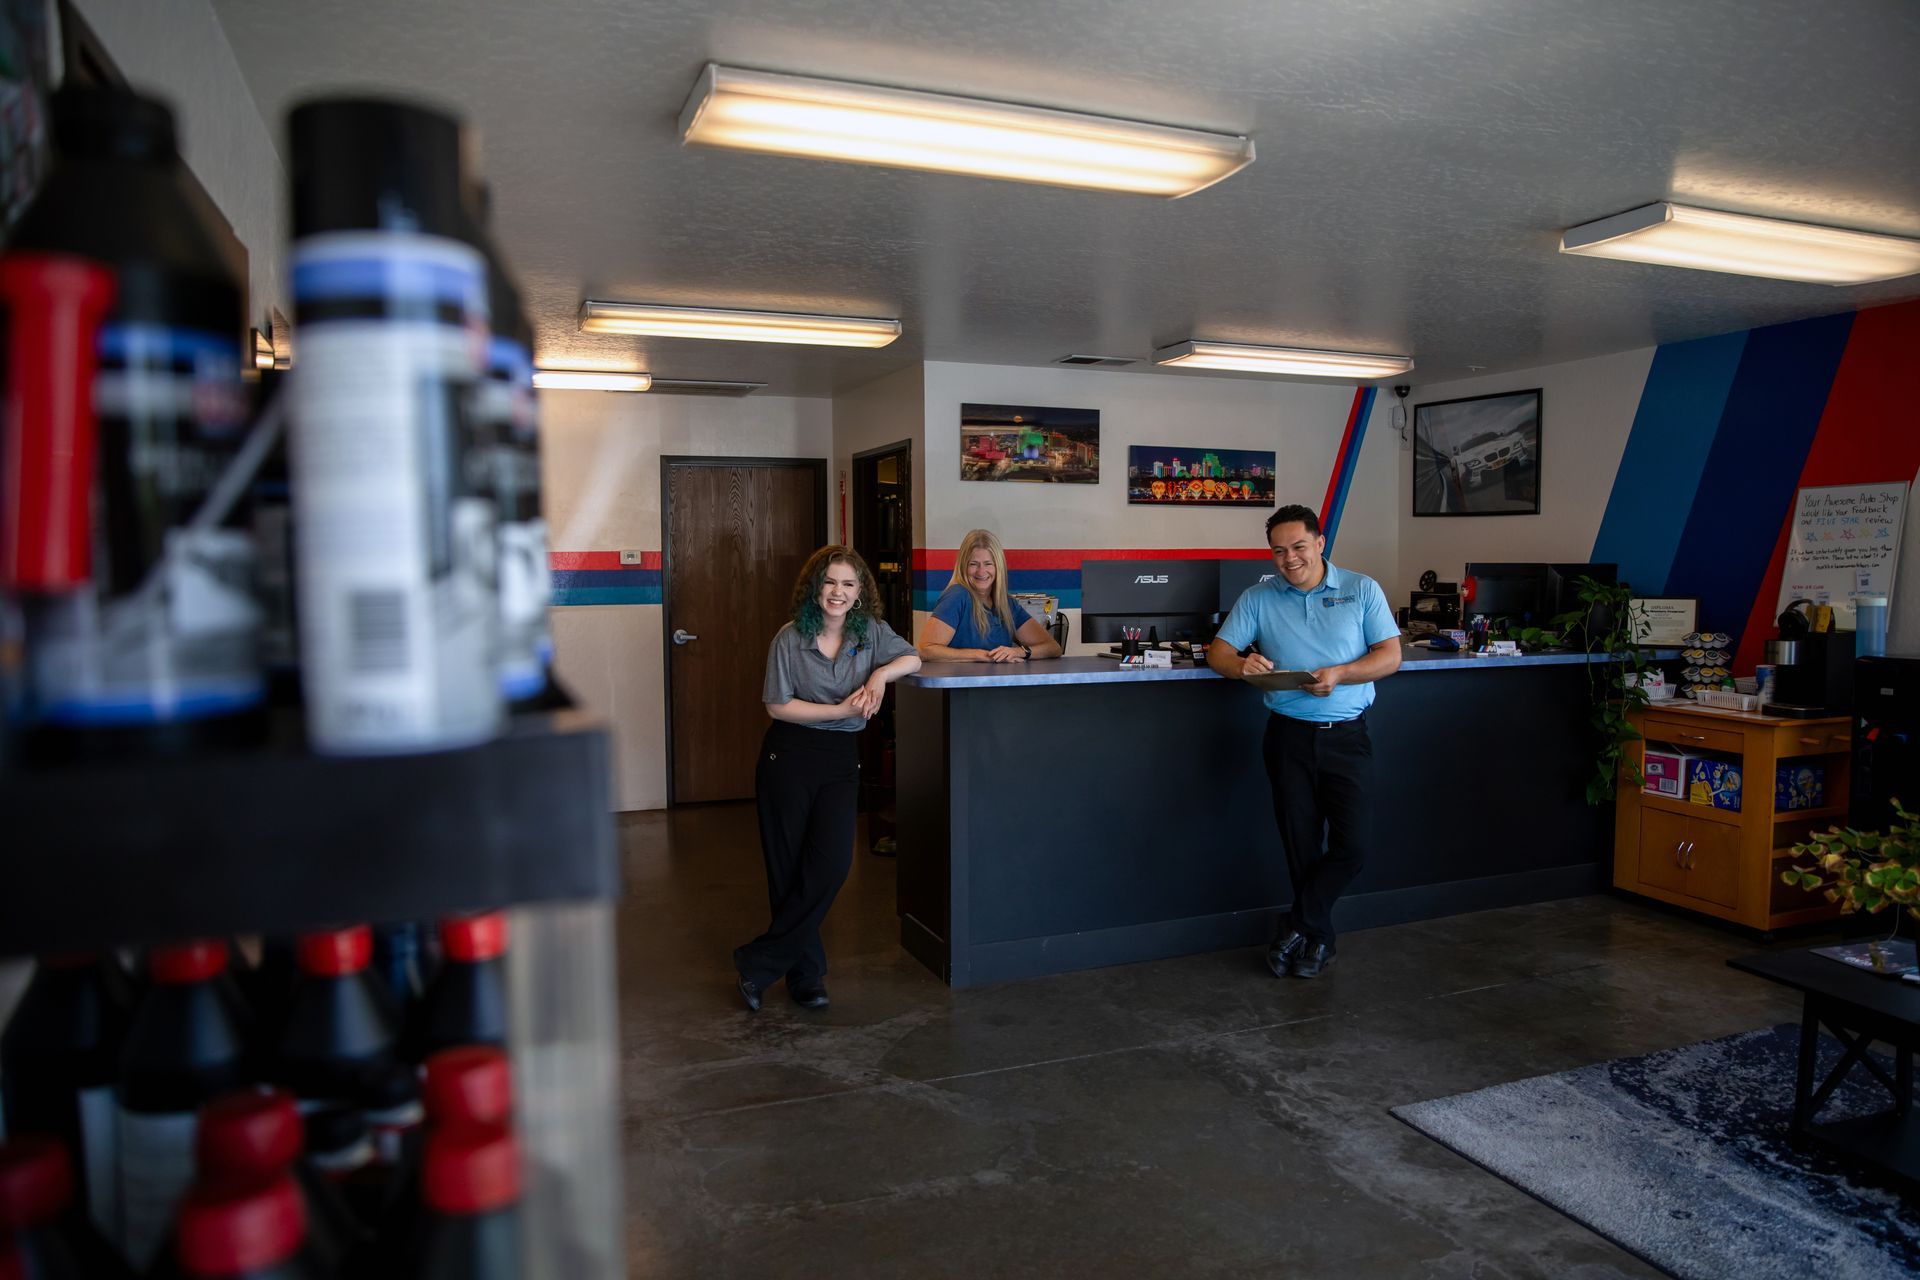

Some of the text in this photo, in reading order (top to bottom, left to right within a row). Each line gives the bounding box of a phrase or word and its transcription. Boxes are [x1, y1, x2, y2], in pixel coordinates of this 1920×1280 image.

[1804, 492, 1899, 507] Your Awesome Auto Shop
[1134, 575, 1169, 584] ASUS
